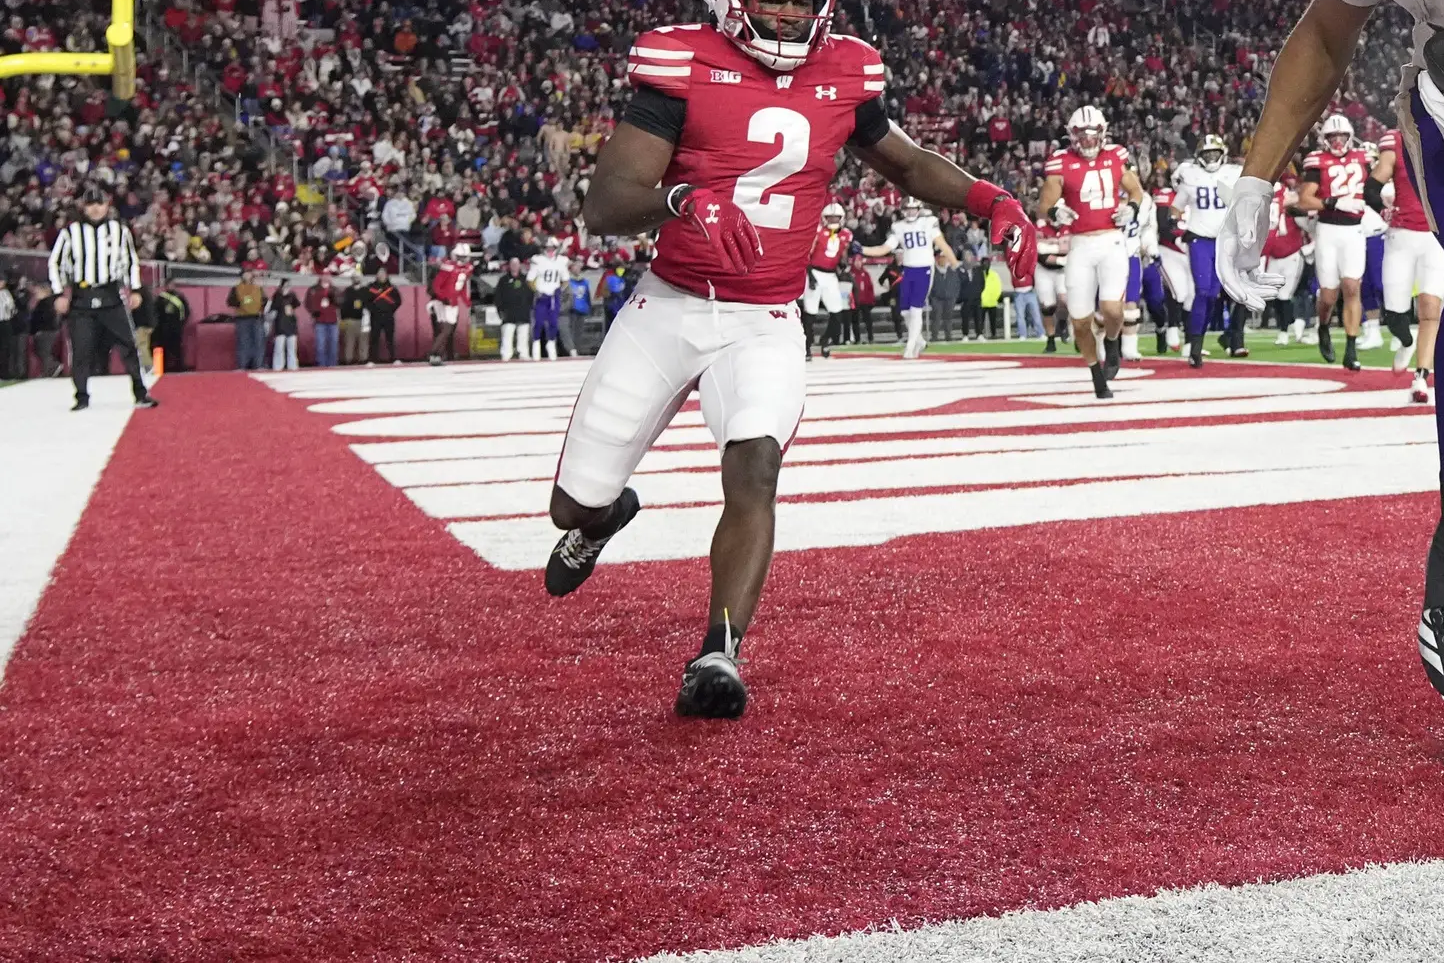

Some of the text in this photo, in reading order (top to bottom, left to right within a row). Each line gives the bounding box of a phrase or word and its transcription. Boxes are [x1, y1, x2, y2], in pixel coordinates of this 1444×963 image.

[776, 75, 794, 89] W
[732, 106, 811, 230] 2
[1328, 163, 1365, 198] 22
[1079, 168, 1115, 210] 41
[903, 230, 928, 250] 86
